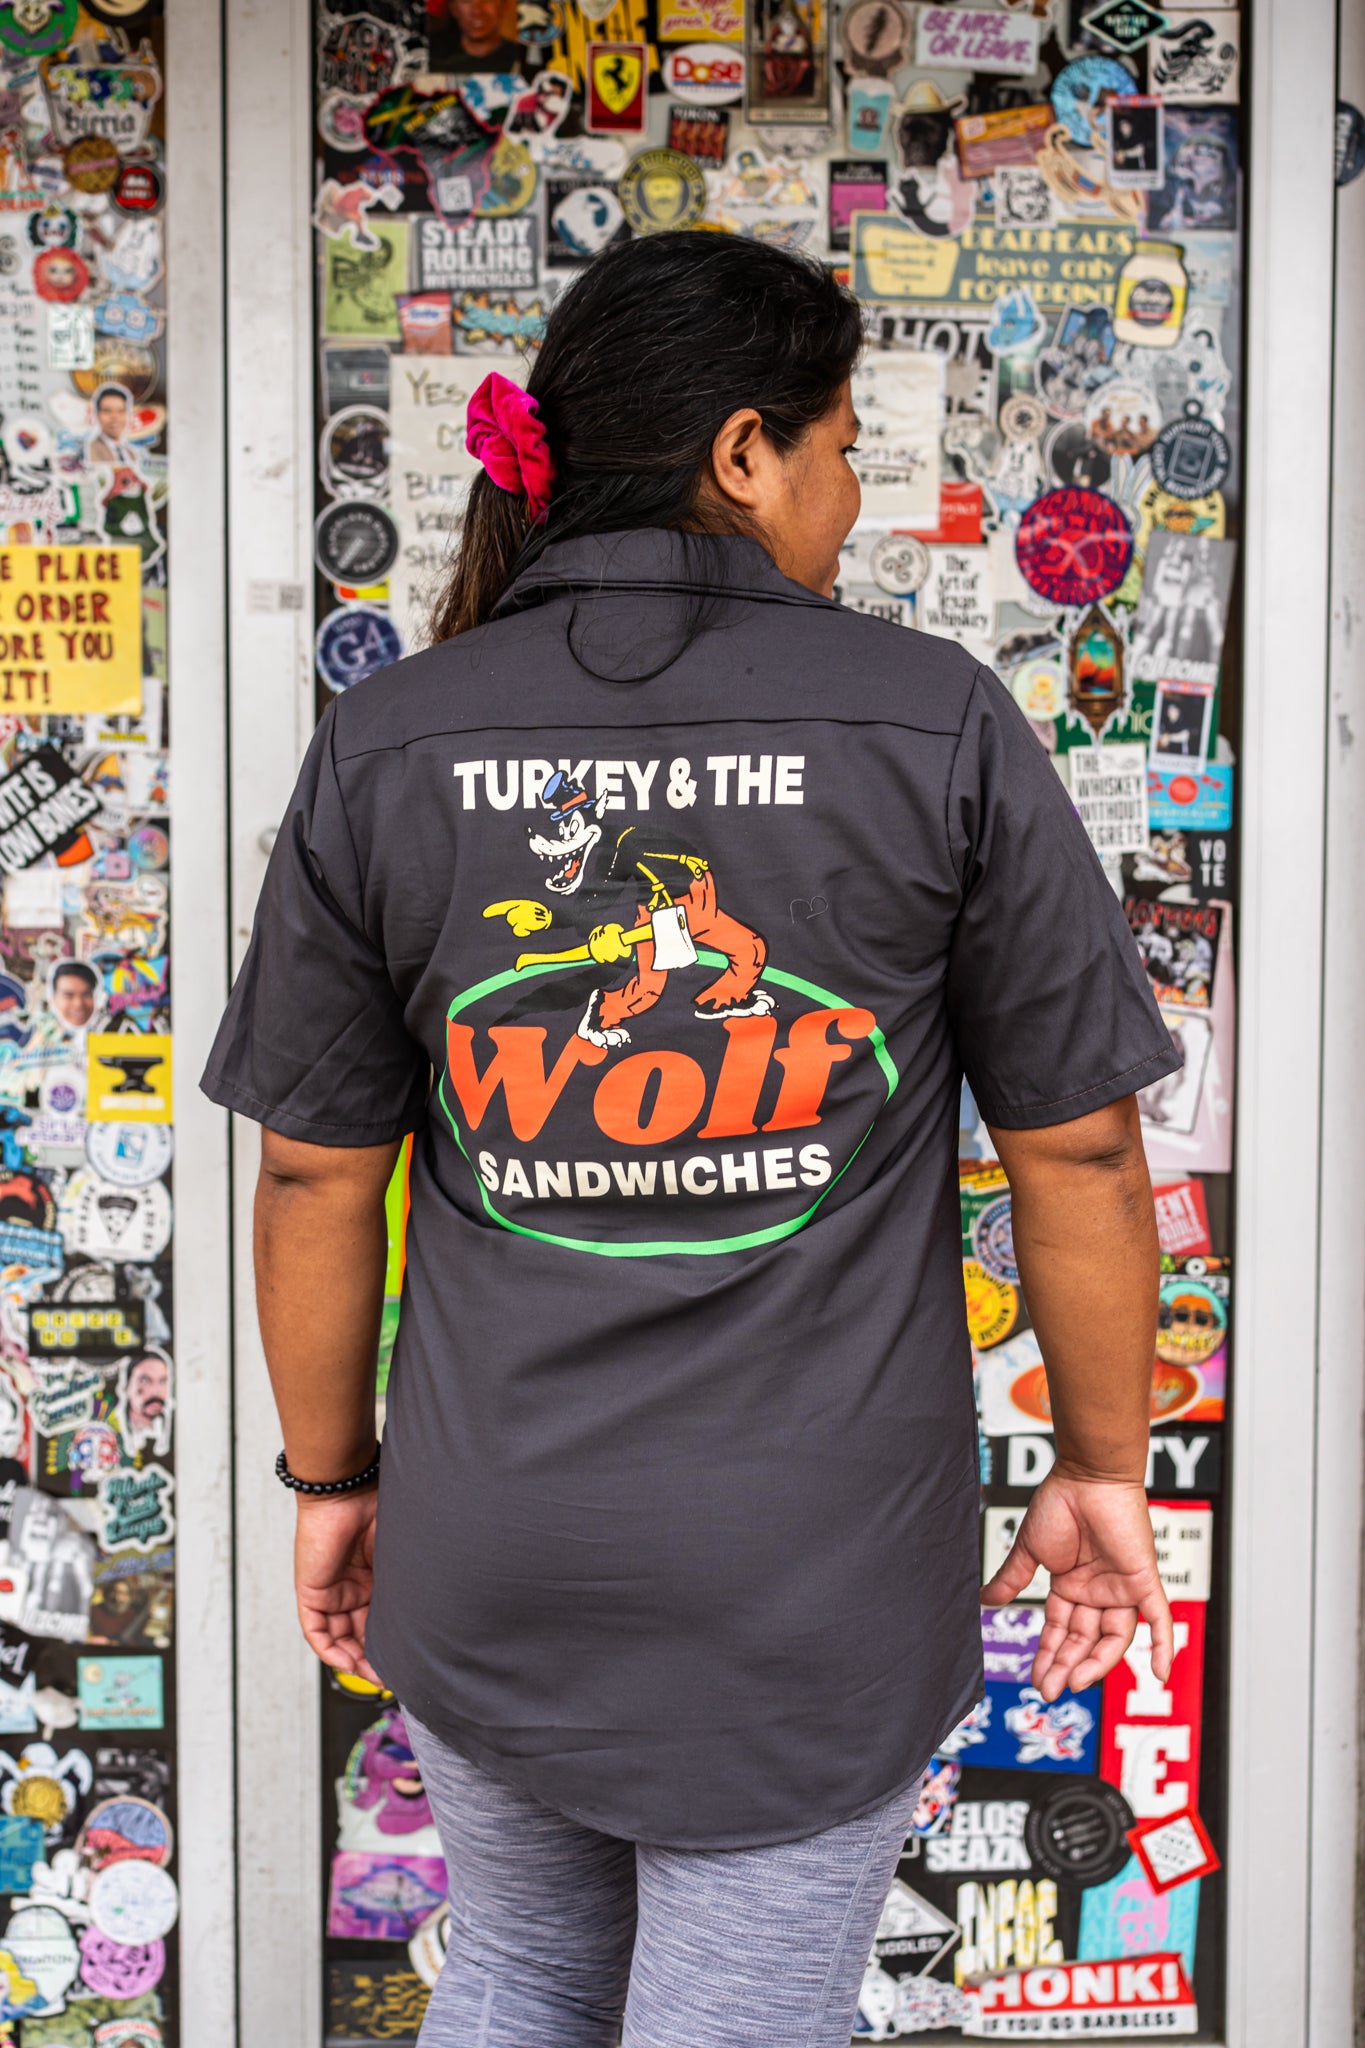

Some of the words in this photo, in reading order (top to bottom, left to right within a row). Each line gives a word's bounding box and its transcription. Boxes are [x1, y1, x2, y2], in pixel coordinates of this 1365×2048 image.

[923, 10, 956, 32] BE
[957, 13, 1010, 37] NICE
[929, 35, 960, 56] OR
[672, 56, 743, 84] Dose
[422, 219, 531, 246] STEADY
[422, 247, 533, 272] ROLLING
[976, 253, 1050, 279] leave
[37, 553, 121, 582] PLACE
[16, 594, 110, 623] ORDER
[59, 631, 115, 661] YOU
[453, 759, 661, 811] TURKEY
[666, 757, 699, 809] &
[706, 755, 806, 805] THE
[1088, 824, 1144, 847] EGRETS
[446, 1007, 876, 1146] Wolf
[478, 1143, 832, 1199] SANDWICHES
[981, 1961, 1180, 2010] HONK!
[983, 2017, 999, 2032] IF
[1008, 2015, 1042, 2032] YOU
[1048, 2014, 1075, 2030] GO
[1081, 2011, 1177, 2030] BARBLESS
